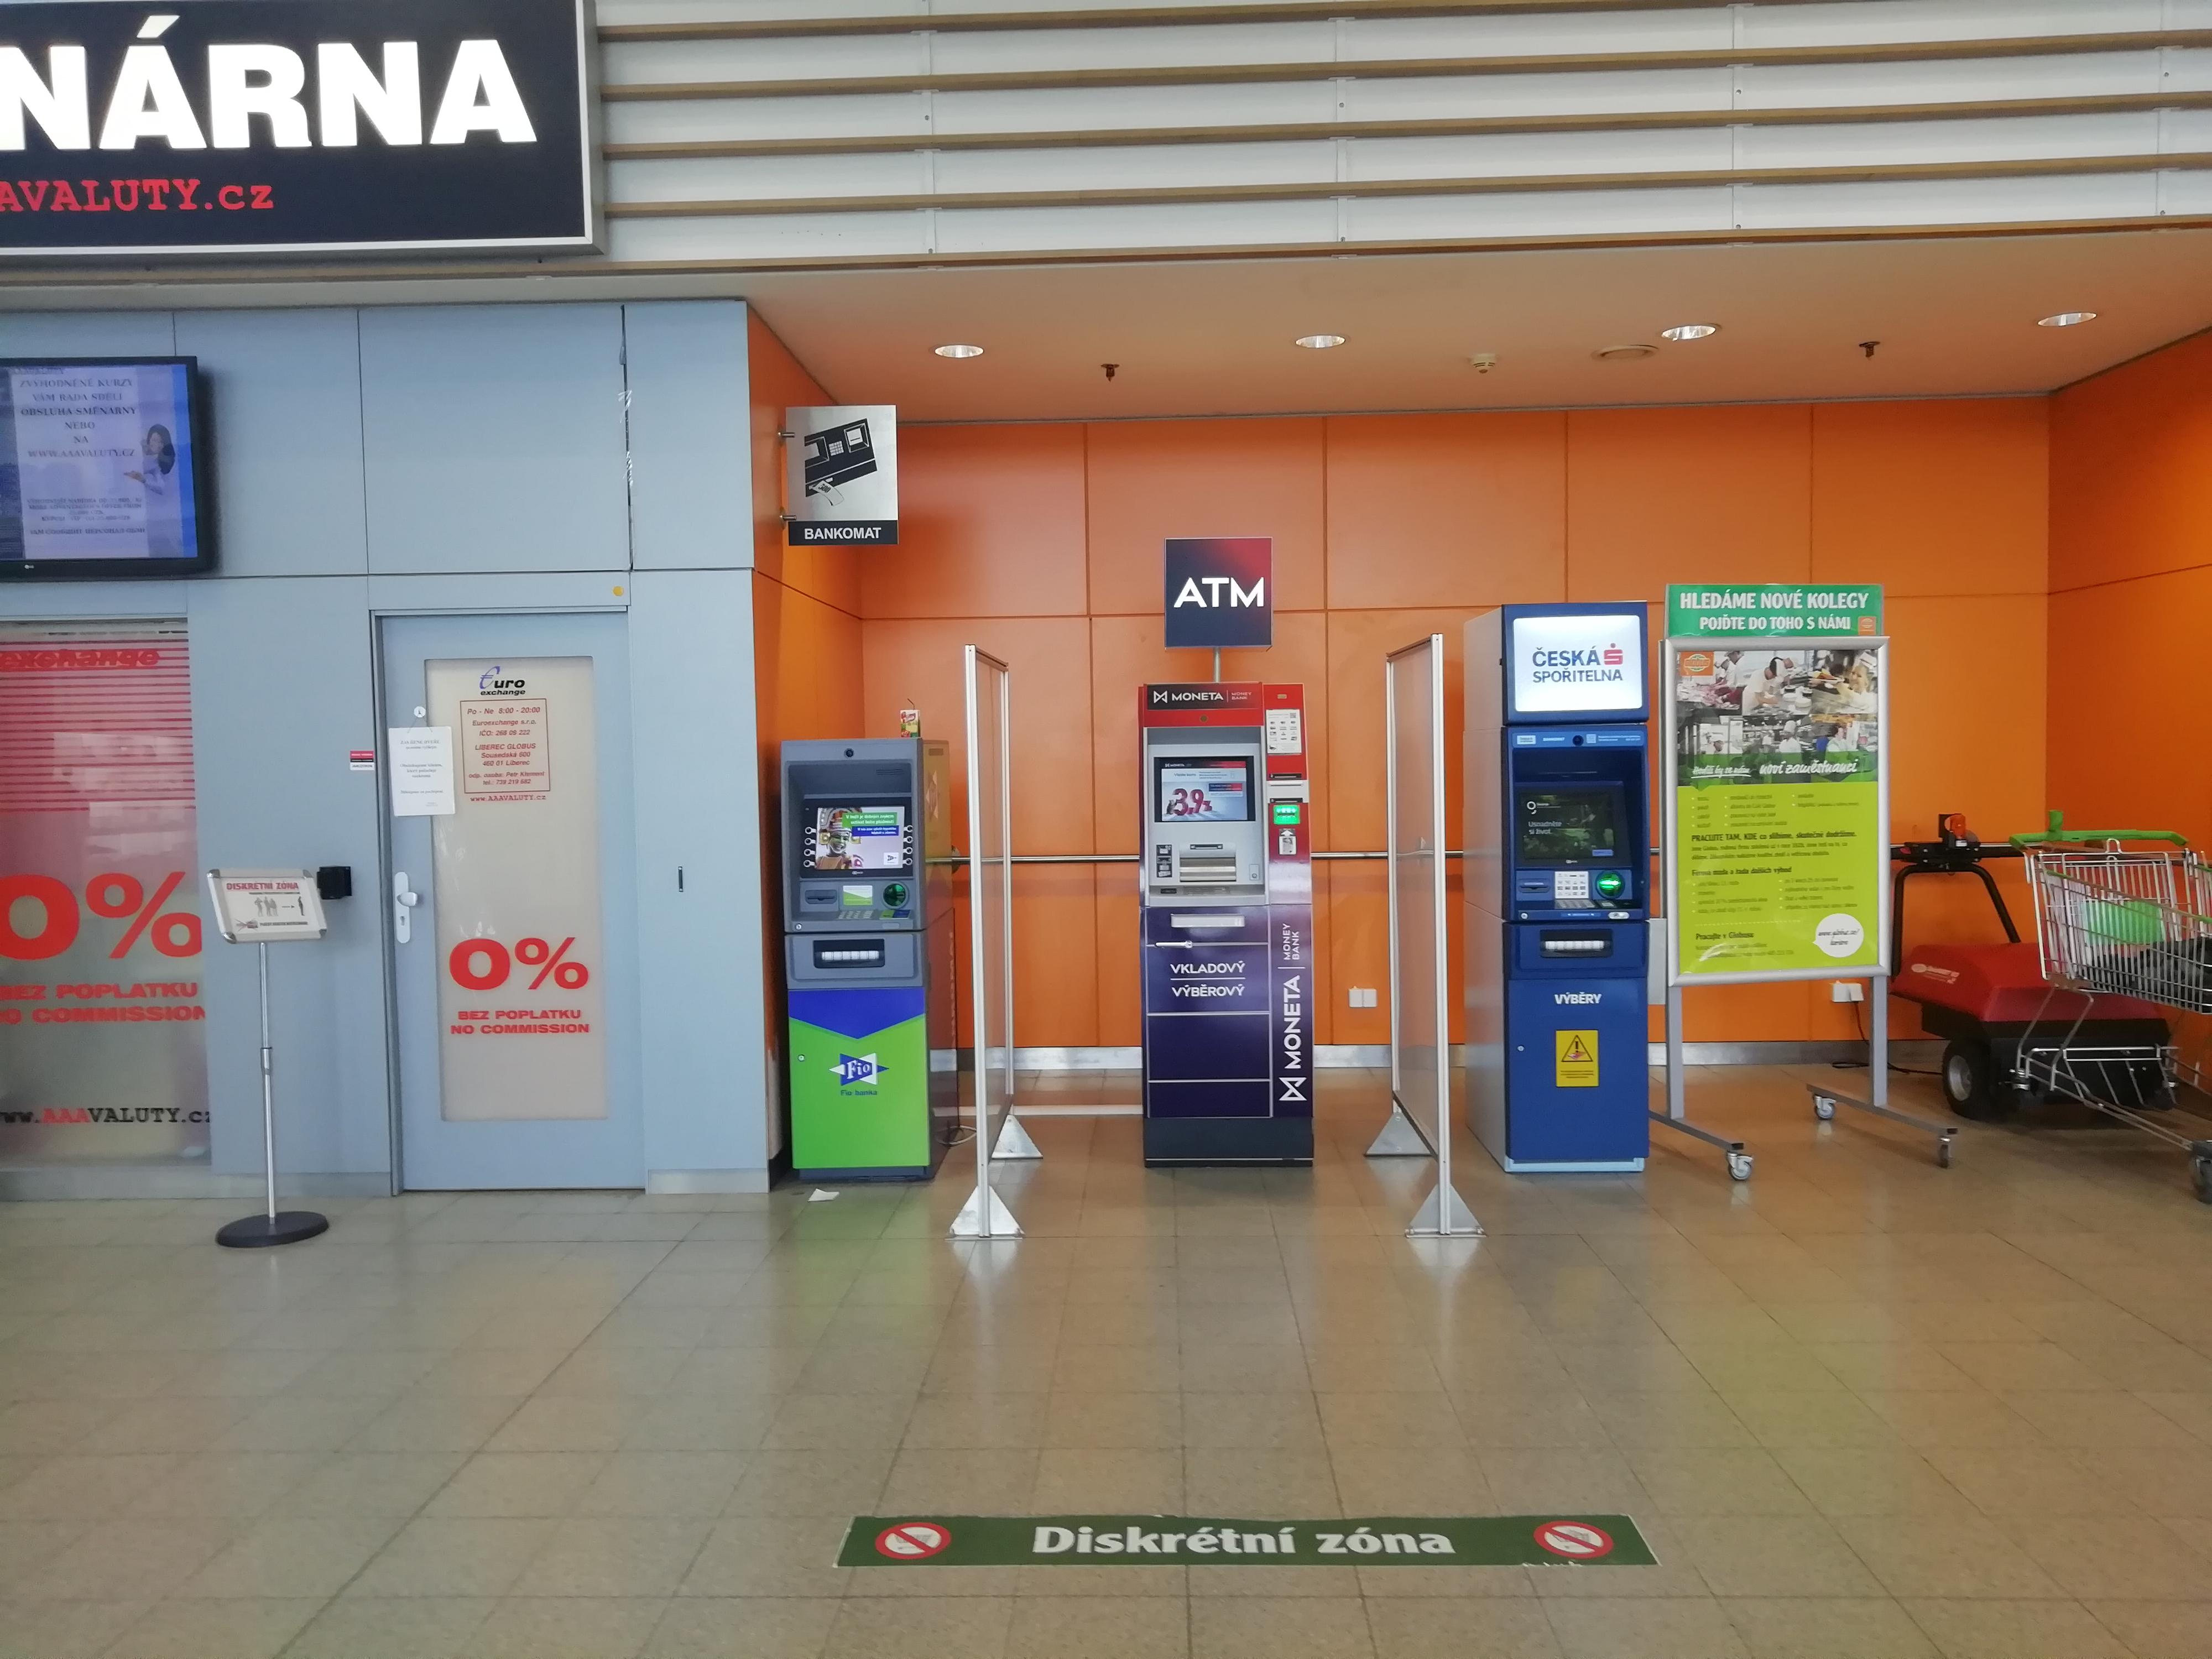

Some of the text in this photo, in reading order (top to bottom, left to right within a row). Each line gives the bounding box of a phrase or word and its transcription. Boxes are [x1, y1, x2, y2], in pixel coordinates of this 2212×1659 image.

[0, 14, 537, 150] NÁRNA
[0, 179, 274, 212] AVALUTY.cz
[804, 527, 881, 540] BANKOMAT
[1173, 577, 1264, 608] ATM
[1680, 589, 1869, 609] HLEDÁME NOVÉ KOLEGY
[1699, 614, 1851, 630] POJĎTE DO TOHO S NÁMI
[1532, 645, 1601, 666] ČESKÁ
[1533, 668, 1623, 682] SPOŘITELNA
[1172, 692, 1224, 701] MONETA
[226, 881, 299, 890] DISKRÉTNÍ ZÓNA
[0, 872, 202, 960] 0%
[1282, 923, 1292, 960] MONEY
[1292, 931, 1300, 960] BANK
[449, 937, 588, 990] 0%
[1170, 961, 1245, 974] VKLADOVÝ
[56, 983, 197, 999] POPLATKU
[1171, 983, 1245, 997] VÝBĚROVÝ
[1554, 992, 1602, 1004] VÝBĚRY
[32, 1005, 206, 1024] COMMISSION
[458, 1010, 581, 1020] BEZ POPLATKU
[1284, 974, 1302, 1070] MONETA
[451, 1024, 589, 1034] NO COMMISSION
[846, 1060, 870, 1079] Fio
[1032, 1526, 1456, 1554] Diskrétní zóna
